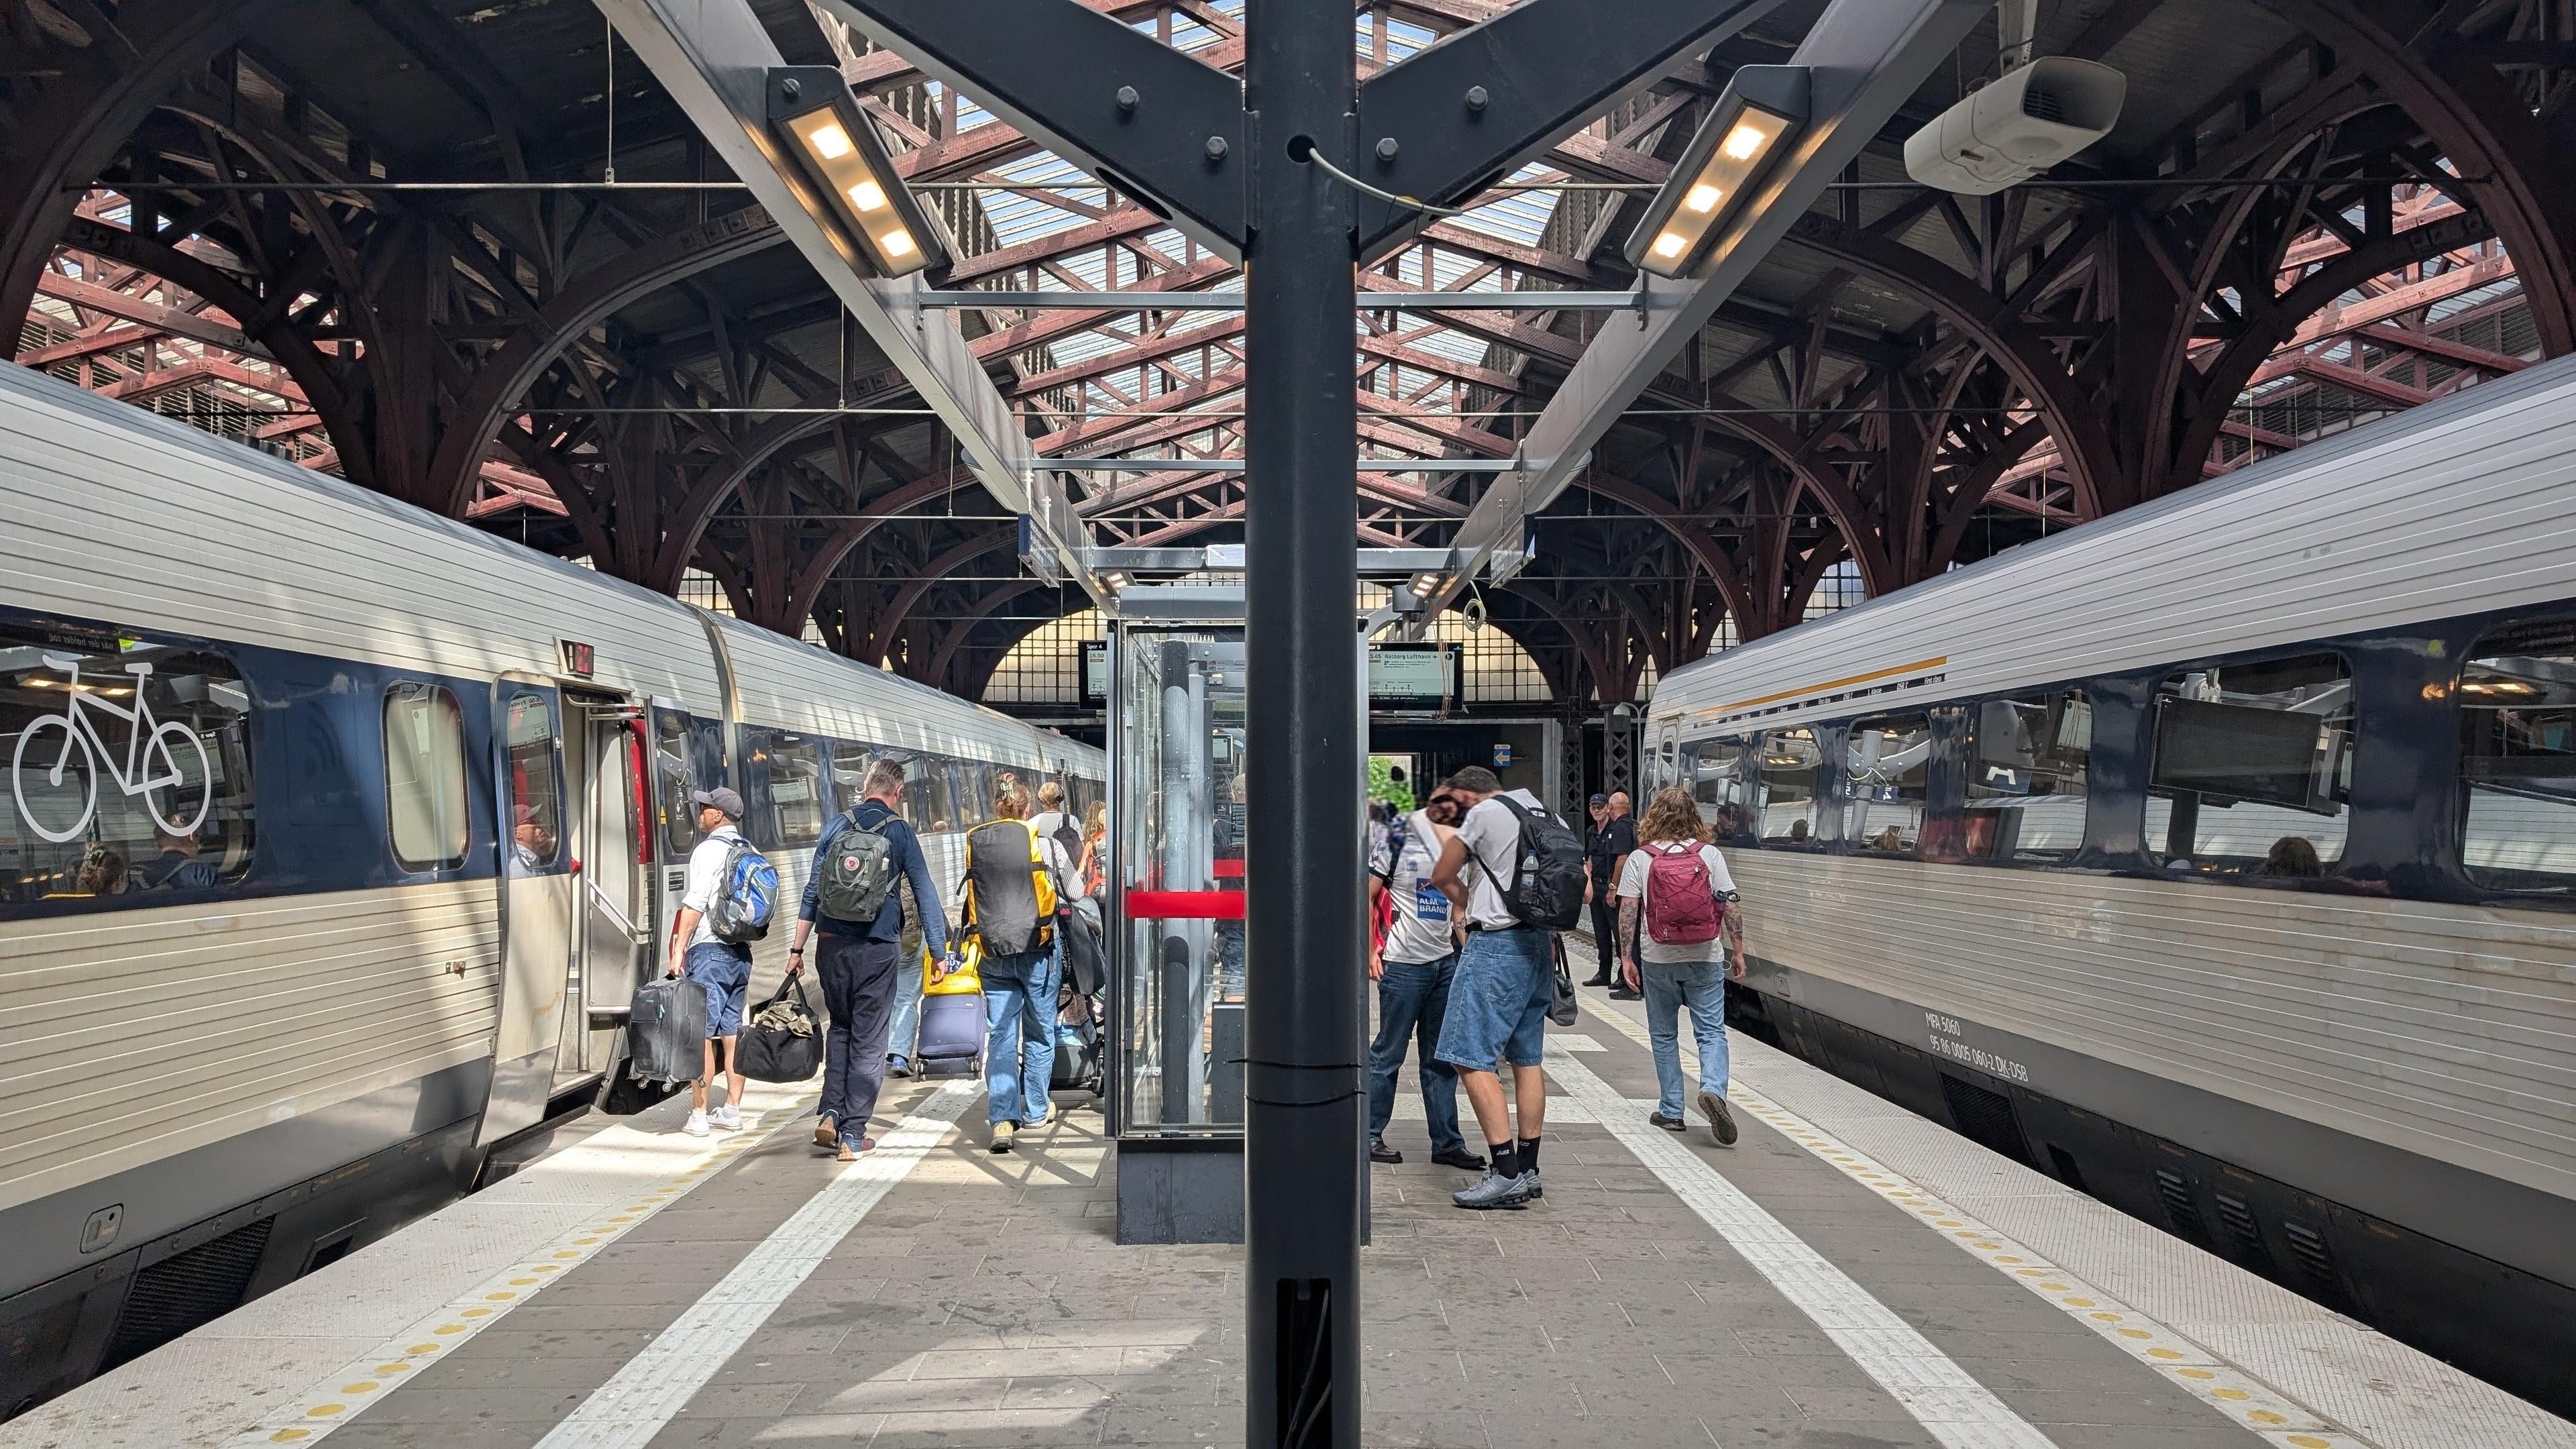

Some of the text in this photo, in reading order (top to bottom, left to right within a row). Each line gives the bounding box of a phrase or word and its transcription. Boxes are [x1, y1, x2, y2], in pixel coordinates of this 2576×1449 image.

[1419, 905, 1446, 914] BRAND
[1925, 1012, 1960, 1036] MFA 5060
[1930, 1034, 2028, 1082] 95 86 0005 060-2 DK-DSB
